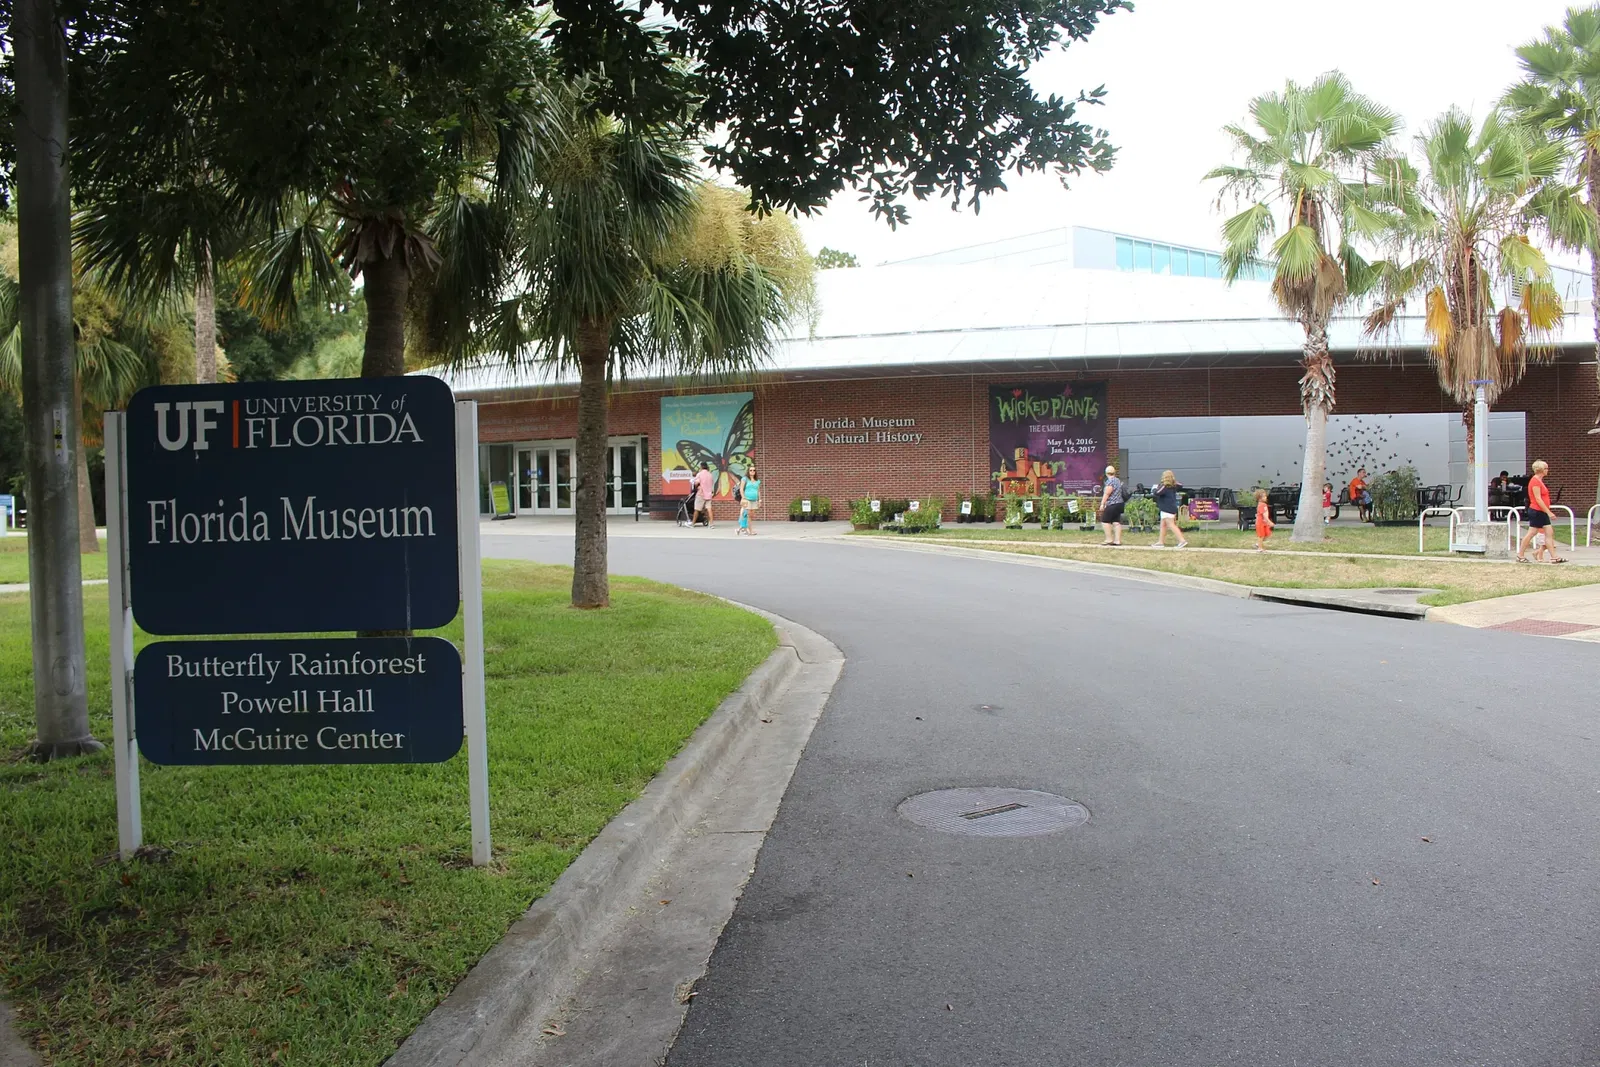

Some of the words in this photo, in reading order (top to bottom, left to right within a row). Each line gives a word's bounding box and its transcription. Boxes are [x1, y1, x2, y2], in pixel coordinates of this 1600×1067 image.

[245, 394, 382, 415] UNIVERSITY
[391, 393, 407, 413] of
[996, 390, 1049, 425] WICKED
[1051, 395, 1099, 423] PLANTS
[154, 400, 224, 451] UF
[245, 412, 424, 449] FLORIDA
[813, 418, 855, 430] Florida
[862, 417, 916, 429] Museum
[1029, 425, 1041, 433] THE
[1042, 424, 1065, 433] EXHIBIT
[806, 433, 819, 445] of
[825, 432, 869, 444] Natural
[876, 431, 923, 445] History
[1047, 438, 1062, 447] May
[1064, 438, 1074, 446] 14,
[1051, 446, 1065, 455] Jan.
[1066, 446, 1077, 454] 15,
[669, 471, 692, 479] Entrance
[147, 496, 270, 544] Florida
[281, 496, 436, 541] Museum
[166, 653, 281, 684] Butterfly
[289, 652, 426, 675] Rainforest
[221, 691, 308, 714] Powell
[318, 689, 375, 713] Hall
[193, 728, 309, 751] McGuire
[316, 726, 406, 749] Center
